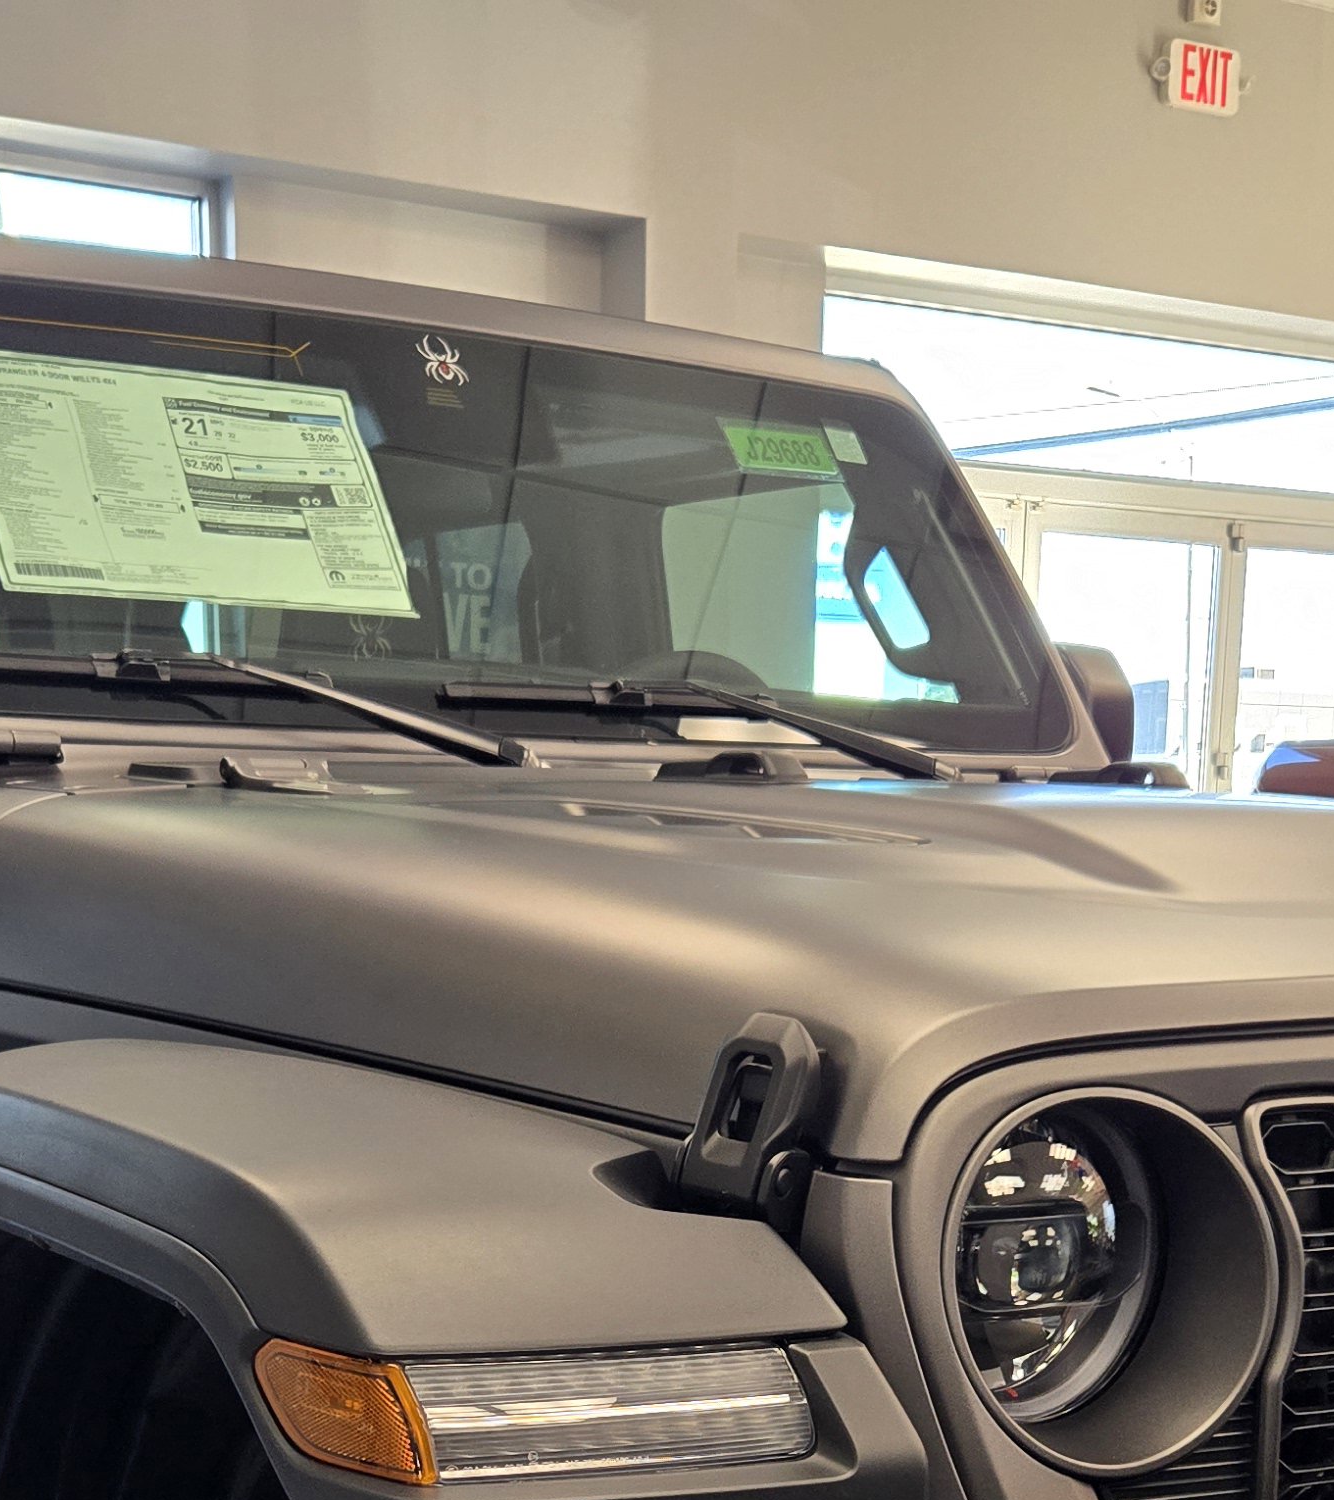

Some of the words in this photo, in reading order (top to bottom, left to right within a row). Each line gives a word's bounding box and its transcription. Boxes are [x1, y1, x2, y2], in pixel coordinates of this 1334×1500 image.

[1180, 43, 1233, 108] EXIT
[181, 417, 208, 436] 21
[300, 432, 340, 444] $3,000
[746, 436, 821, 467] J29688
[183, 458, 224, 472] $2,500
